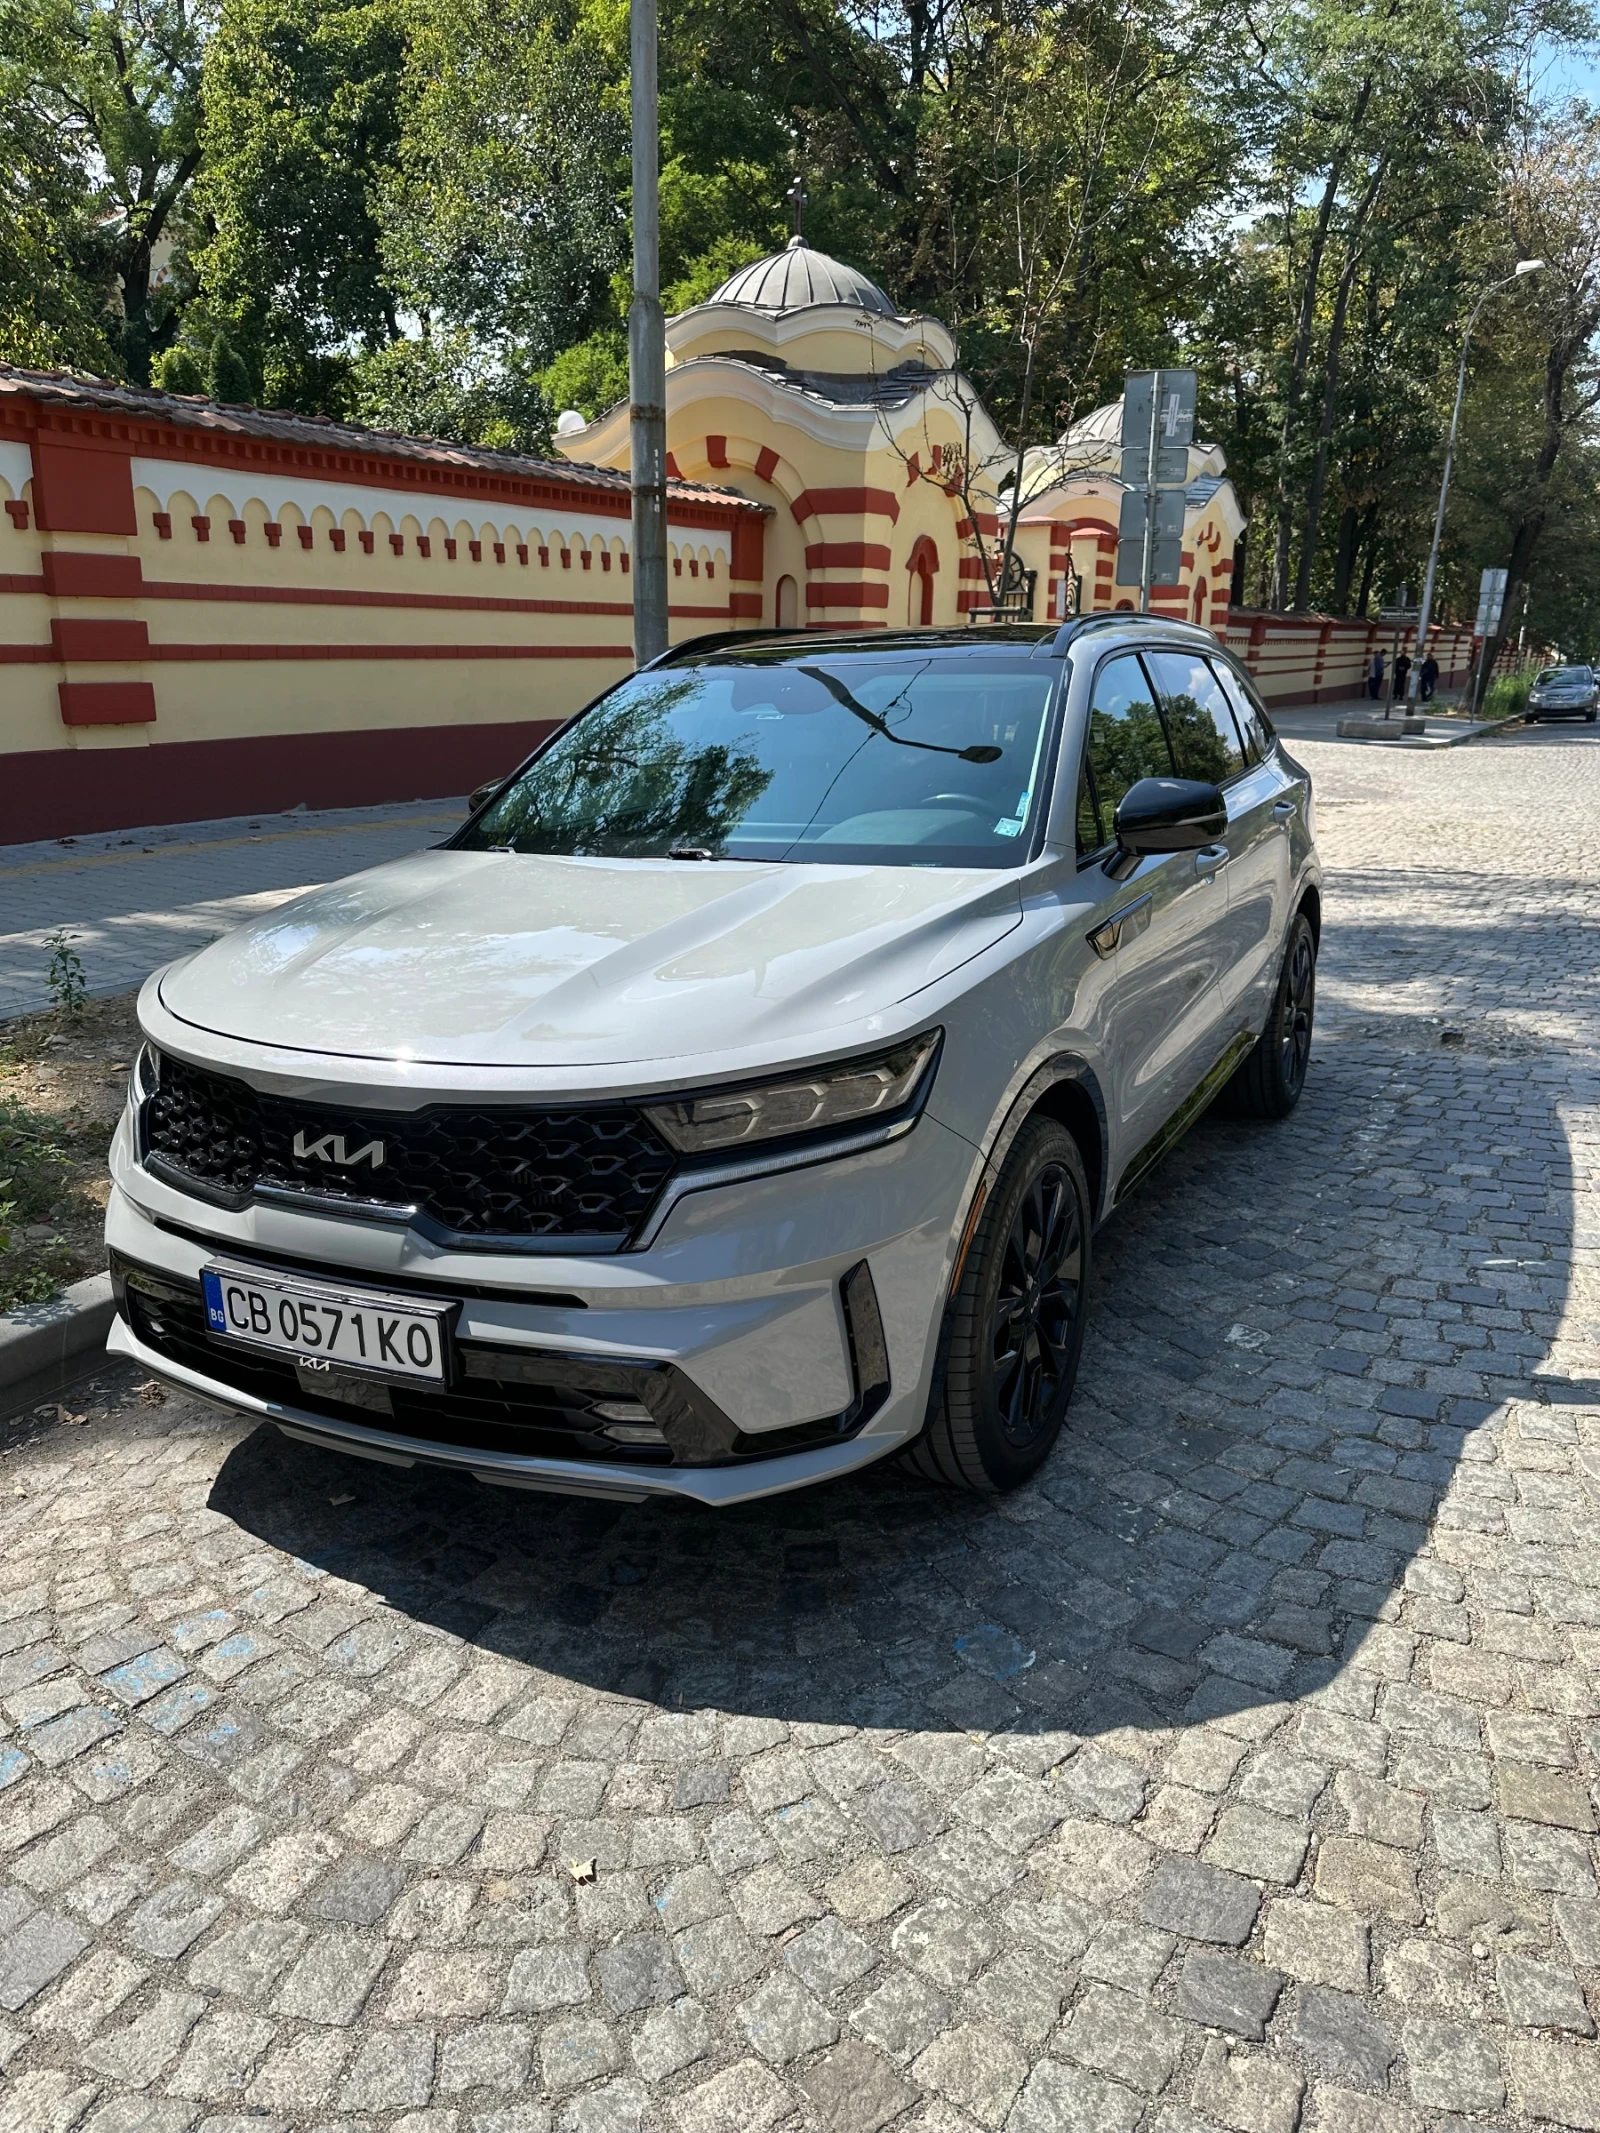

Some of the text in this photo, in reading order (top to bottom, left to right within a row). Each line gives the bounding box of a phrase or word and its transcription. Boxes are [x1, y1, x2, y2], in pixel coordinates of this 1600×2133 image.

[293, 1130, 384, 1169] KIA
[210, 1308, 224, 1323] BG
[227, 1286, 433, 1368] CB 0571 KO
[299, 1356, 330, 1371] KIA
